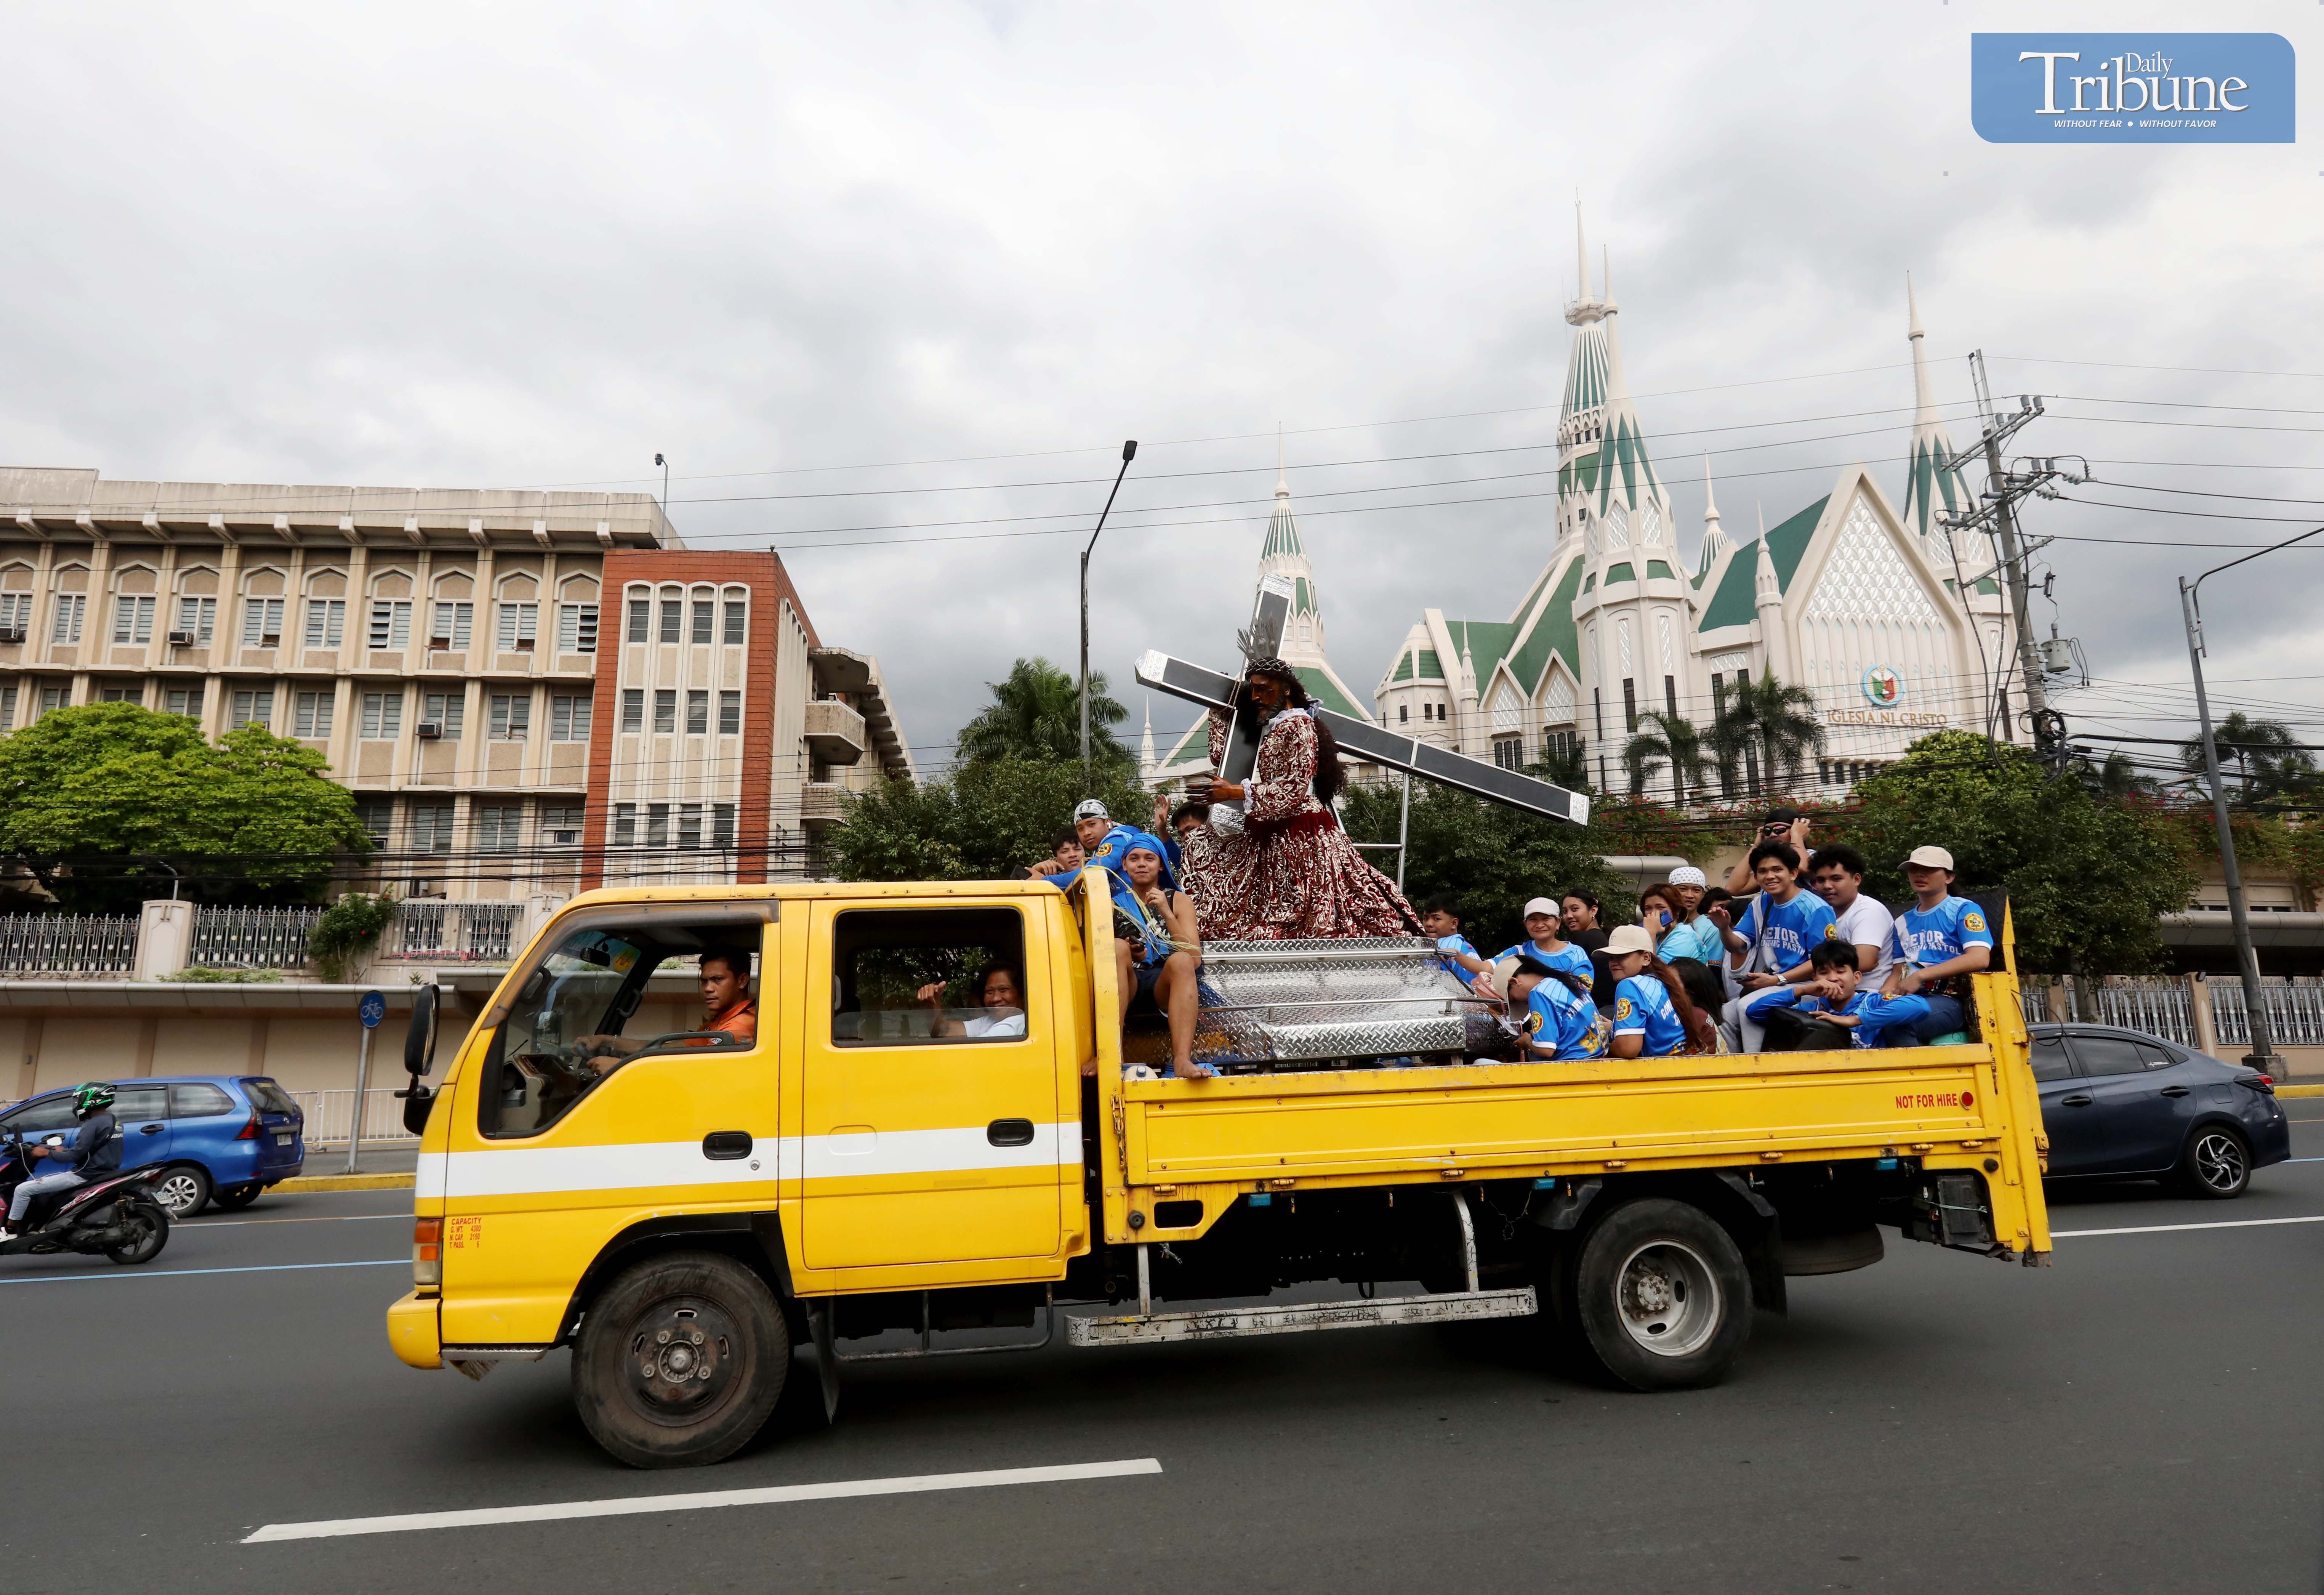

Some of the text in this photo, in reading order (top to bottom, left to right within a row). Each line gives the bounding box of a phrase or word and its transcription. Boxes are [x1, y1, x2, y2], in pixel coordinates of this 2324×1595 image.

[1826, 710, 1948, 726] IGLESIA NI CRISTO
[1895, 1093, 1958, 1109] NOT FOR HIRE
[451, 1217, 482, 1225] CAPACITY
